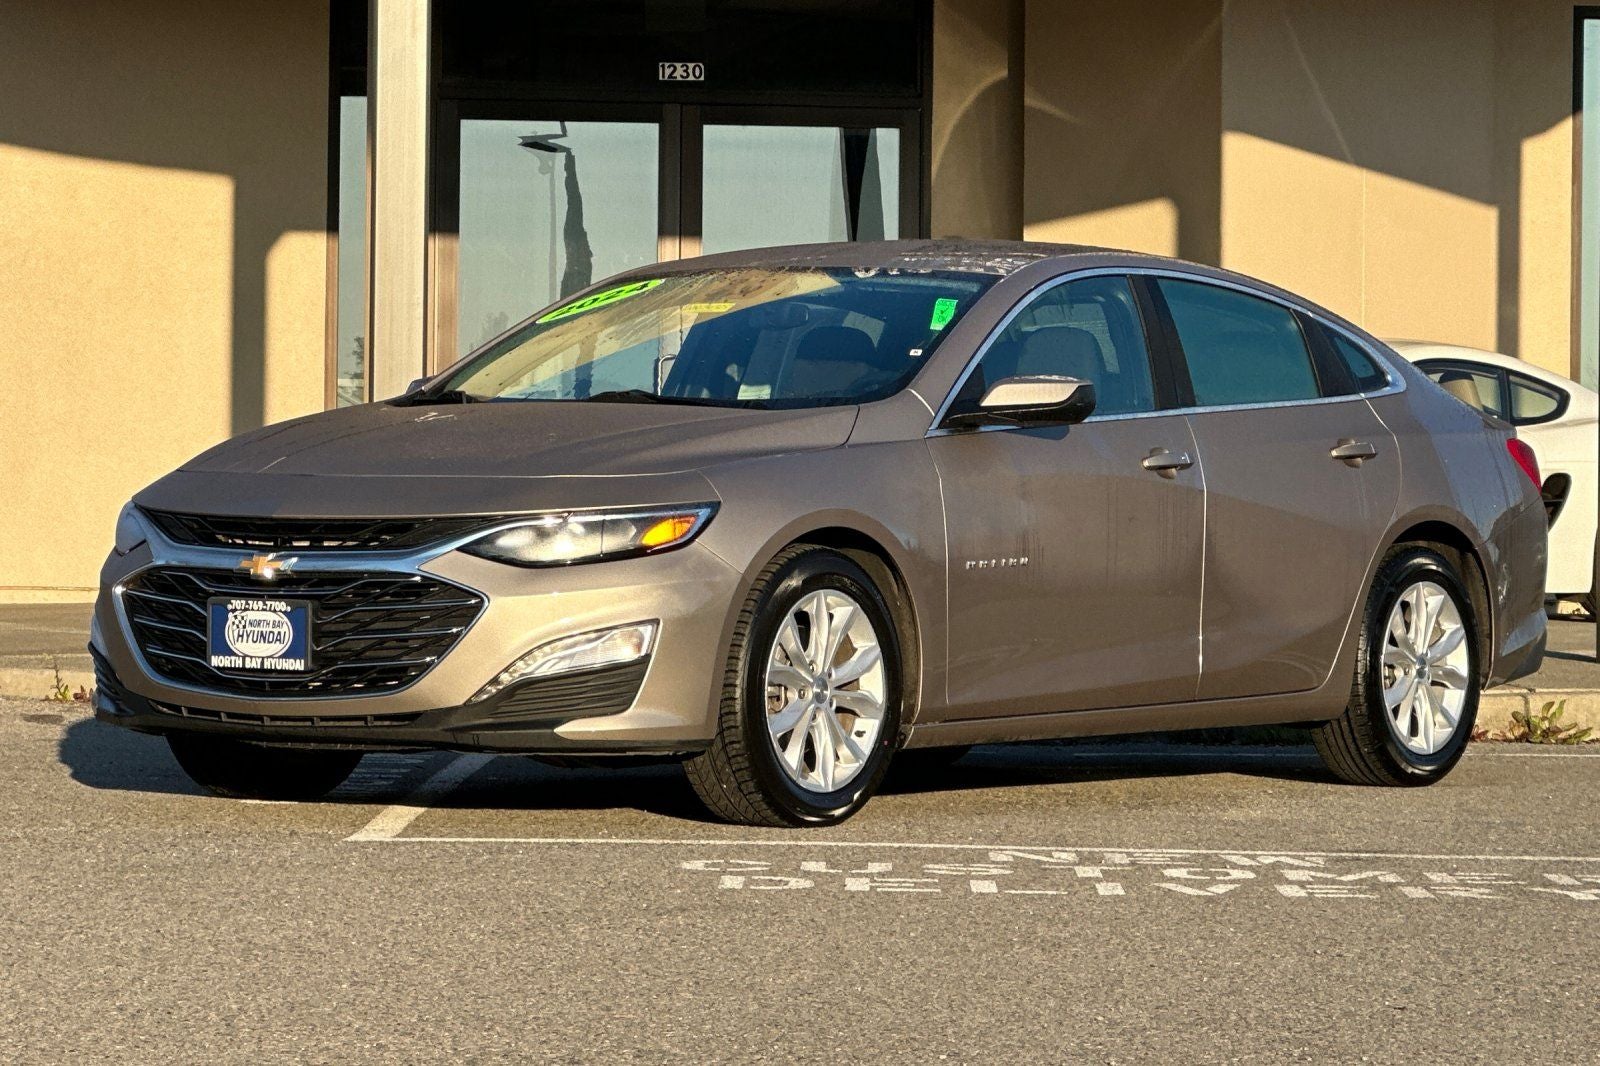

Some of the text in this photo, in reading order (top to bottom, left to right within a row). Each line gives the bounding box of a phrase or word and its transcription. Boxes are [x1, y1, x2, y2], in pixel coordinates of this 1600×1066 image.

[660, 63, 703, 80] 1230
[549, 282, 649, 320] 2024
[230, 600, 287, 611] 707-769-7700
[248, 619, 284, 629] NORTH BAY
[237, 629, 286, 645] HYUNDAI
[211, 655, 305, 671] NORTH BAY HYUNDAI
[987, 850, 1326, 868] NEW
